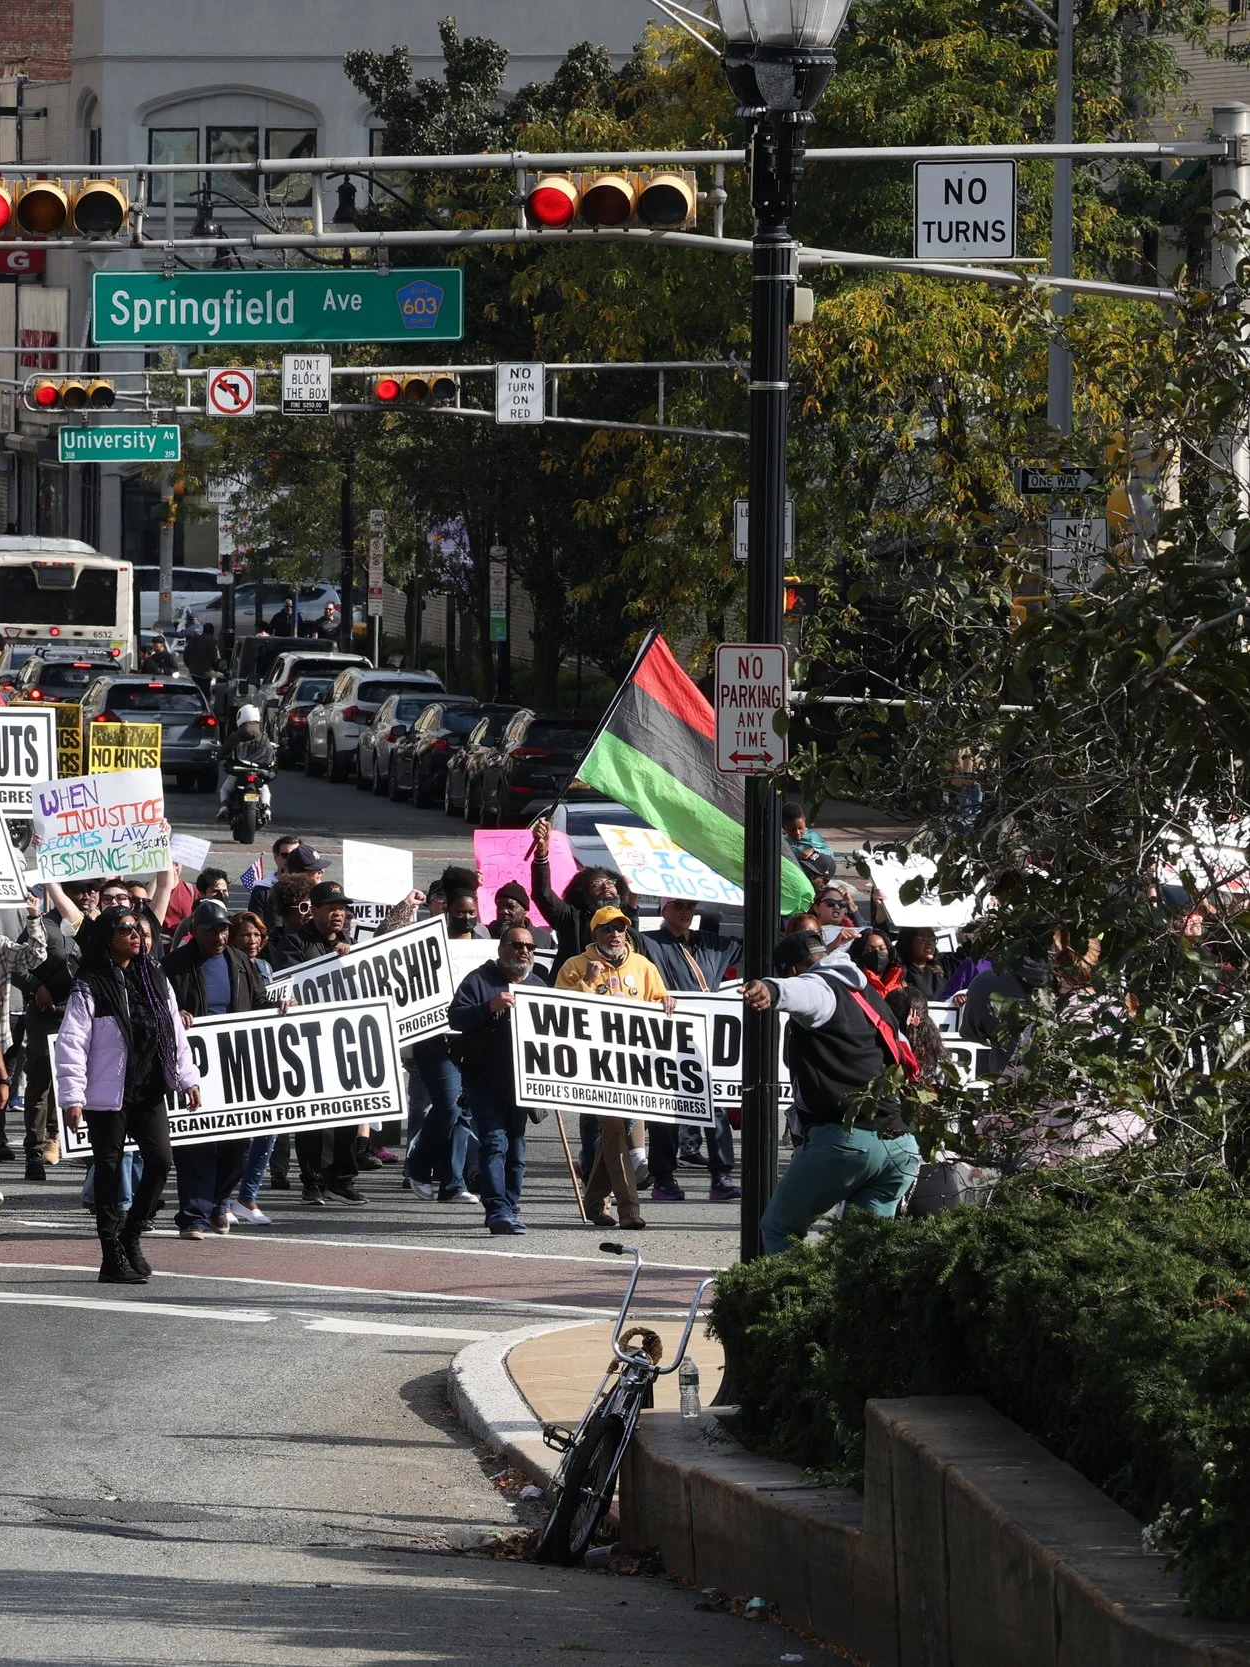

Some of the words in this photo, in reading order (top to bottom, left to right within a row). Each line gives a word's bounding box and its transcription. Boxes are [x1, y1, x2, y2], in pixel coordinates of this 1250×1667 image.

[944, 178, 987, 205] NO
[922, 220, 1006, 243] TURNS
[110, 289, 295, 336] Springfield
[322, 288, 363, 311] Ave
[403, 298, 438, 315] 603
[293, 359, 320, 371] DON'T
[510, 368, 532, 379] NO
[291, 373, 322, 385] BLOCK
[507, 382, 535, 392] TURN
[286, 388, 304, 399] THE
[309, 388, 327, 399] BOX
[512, 395, 529, 405] ON
[510, 409, 531, 418] RED
[64, 431, 157, 452] University
[163, 430, 174, 440] Av
[64, 451, 76, 459] 318
[164, 450, 175, 458] 319
[1057, 475, 1081, 487] WAY
[93, 631, 113, 639] 6532
[738, 656, 764, 680] NO
[720, 685, 781, 709] PARKING
[737, 711, 764, 728] ANY
[735, 731, 768, 748] TIME
[91, 748, 111, 767] NO
[113, 749, 158, 768] KINGS
[39, 780, 100, 817] WHEN
[56, 797, 164, 837] INJUSTICE
[38, 829, 103, 854] BECOMES
[110, 825, 151, 843] LAW
[37, 845, 130, 879] RESISTANCE
[352, 904, 373, 919] WE
[528, 1001, 592, 1041] WE
[600, 1010, 696, 1055] HAVE
[217, 1021, 324, 1105] MUST
[332, 1014, 386, 1091] GO
[524, 1040, 578, 1078] NO
[590, 1048, 705, 1094] KINGS
[526, 1082, 570, 1099] PEOPLE'S
[572, 1086, 639, 1108] ORGANIZATION
[640, 1094, 658, 1109] FOR
[659, 1097, 707, 1115] PROGRESS
[168, 1108, 273, 1134] RGANIZATION
[276, 1105, 308, 1122] FOR
[310, 1095, 392, 1118] PROGRESS
